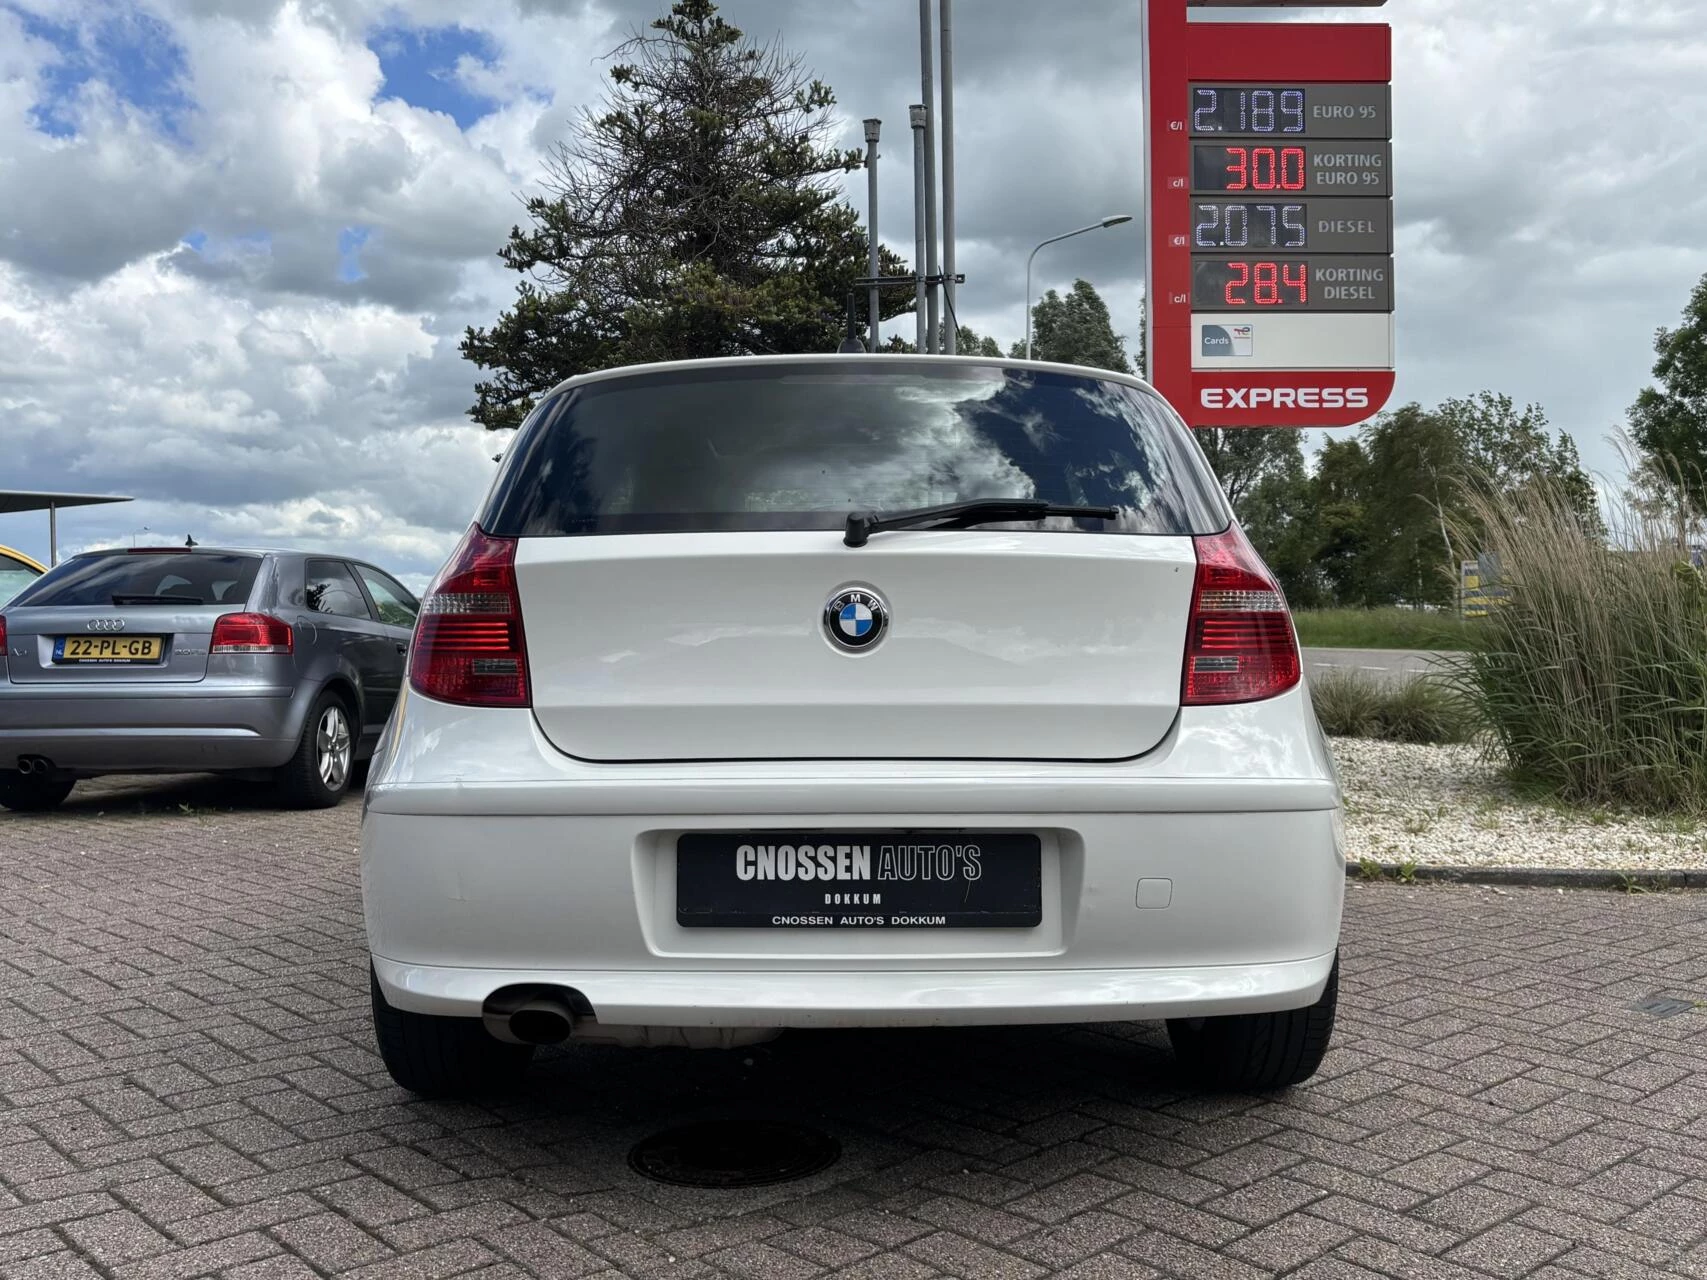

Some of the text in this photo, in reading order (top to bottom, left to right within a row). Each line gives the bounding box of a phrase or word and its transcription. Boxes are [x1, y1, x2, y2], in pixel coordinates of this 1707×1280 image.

[1195, 89, 1304, 132] 2.189
[1313, 105, 1377, 118] EURO 95
[1313, 154, 1382, 167] KORTING
[1226, 148, 1304, 190] 30.0
[1316, 171, 1380, 185] EURO 95
[1196, 205, 1305, 247] 2.075
[1318, 220, 1375, 233] DIESEL
[1315, 268, 1384, 282] KORTING
[1225, 262, 1307, 304] 28.4
[1324, 286, 1375, 299] DIESEL
[1204, 336, 1229, 345] Cards
[1200, 387, 1369, 409] EXPRESS
[834, 593, 879, 612] BMW
[70, 639, 152, 656] 22-PL-GB
[736, 844, 982, 881] CNOSSEN AUTO'S
[824, 893, 882, 905] DOKKUM
[772, 916, 946, 926] CNOSSEN AUTO'S DOKKUM
